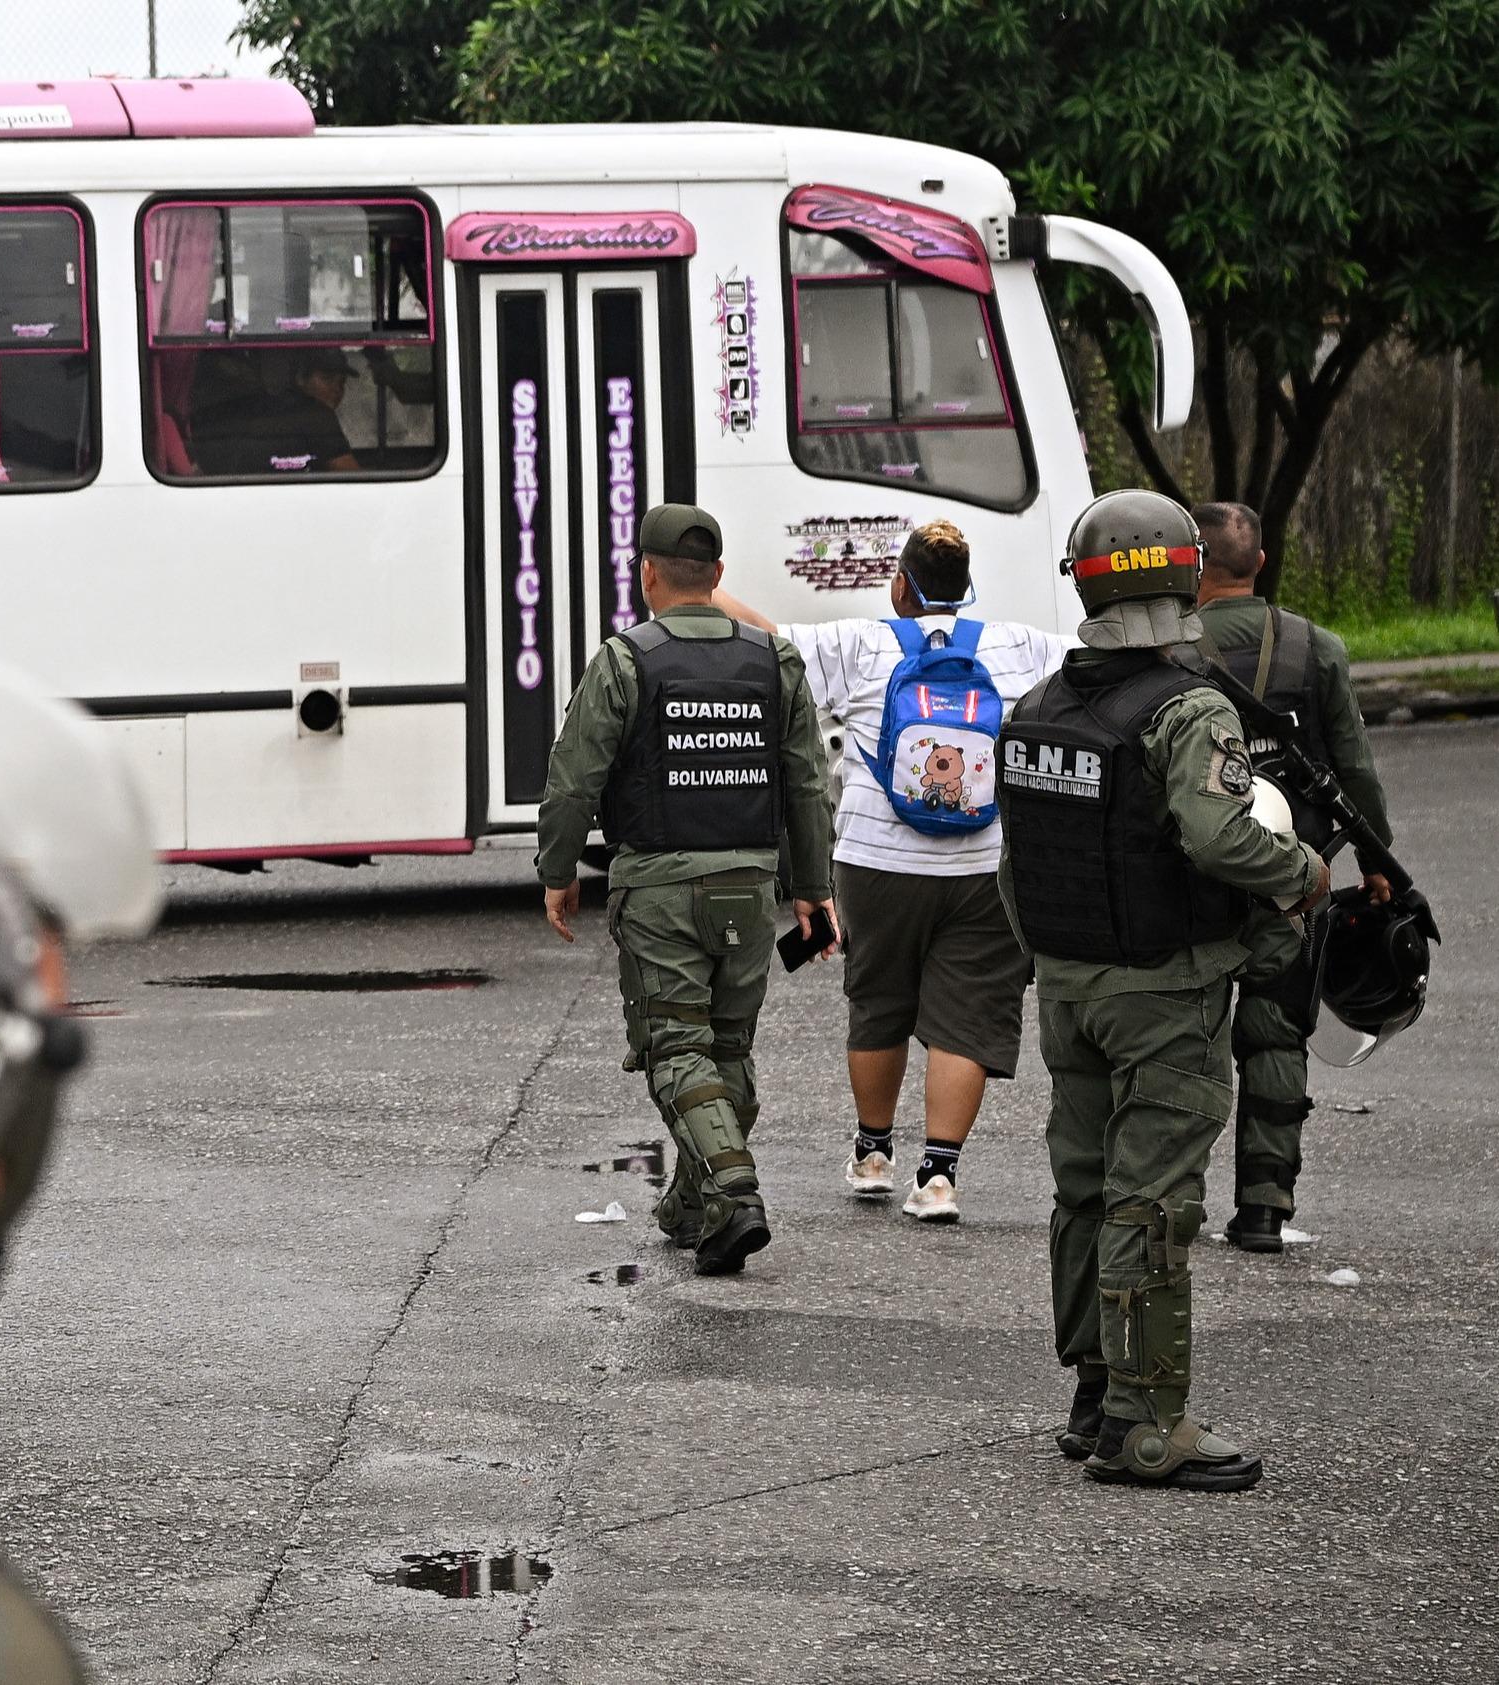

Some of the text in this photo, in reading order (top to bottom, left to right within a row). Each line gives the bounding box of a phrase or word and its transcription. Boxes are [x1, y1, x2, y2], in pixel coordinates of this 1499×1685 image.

[729, 350, 748, 362] DVD
[607, 377, 637, 634] EJECUTIV
[512, 378, 543, 690] SERVICIO
[1110, 546, 1169, 572] GNB
[665, 701, 763, 719] GUARDIA
[667, 731, 765, 750] NACIONAL
[1004, 739, 1102, 780] G.N.B
[668, 768, 769, 786] BOLIVARIANA
[1004, 771, 1100, 799] GUARDIA NACIONAL BOLIVARIANA
